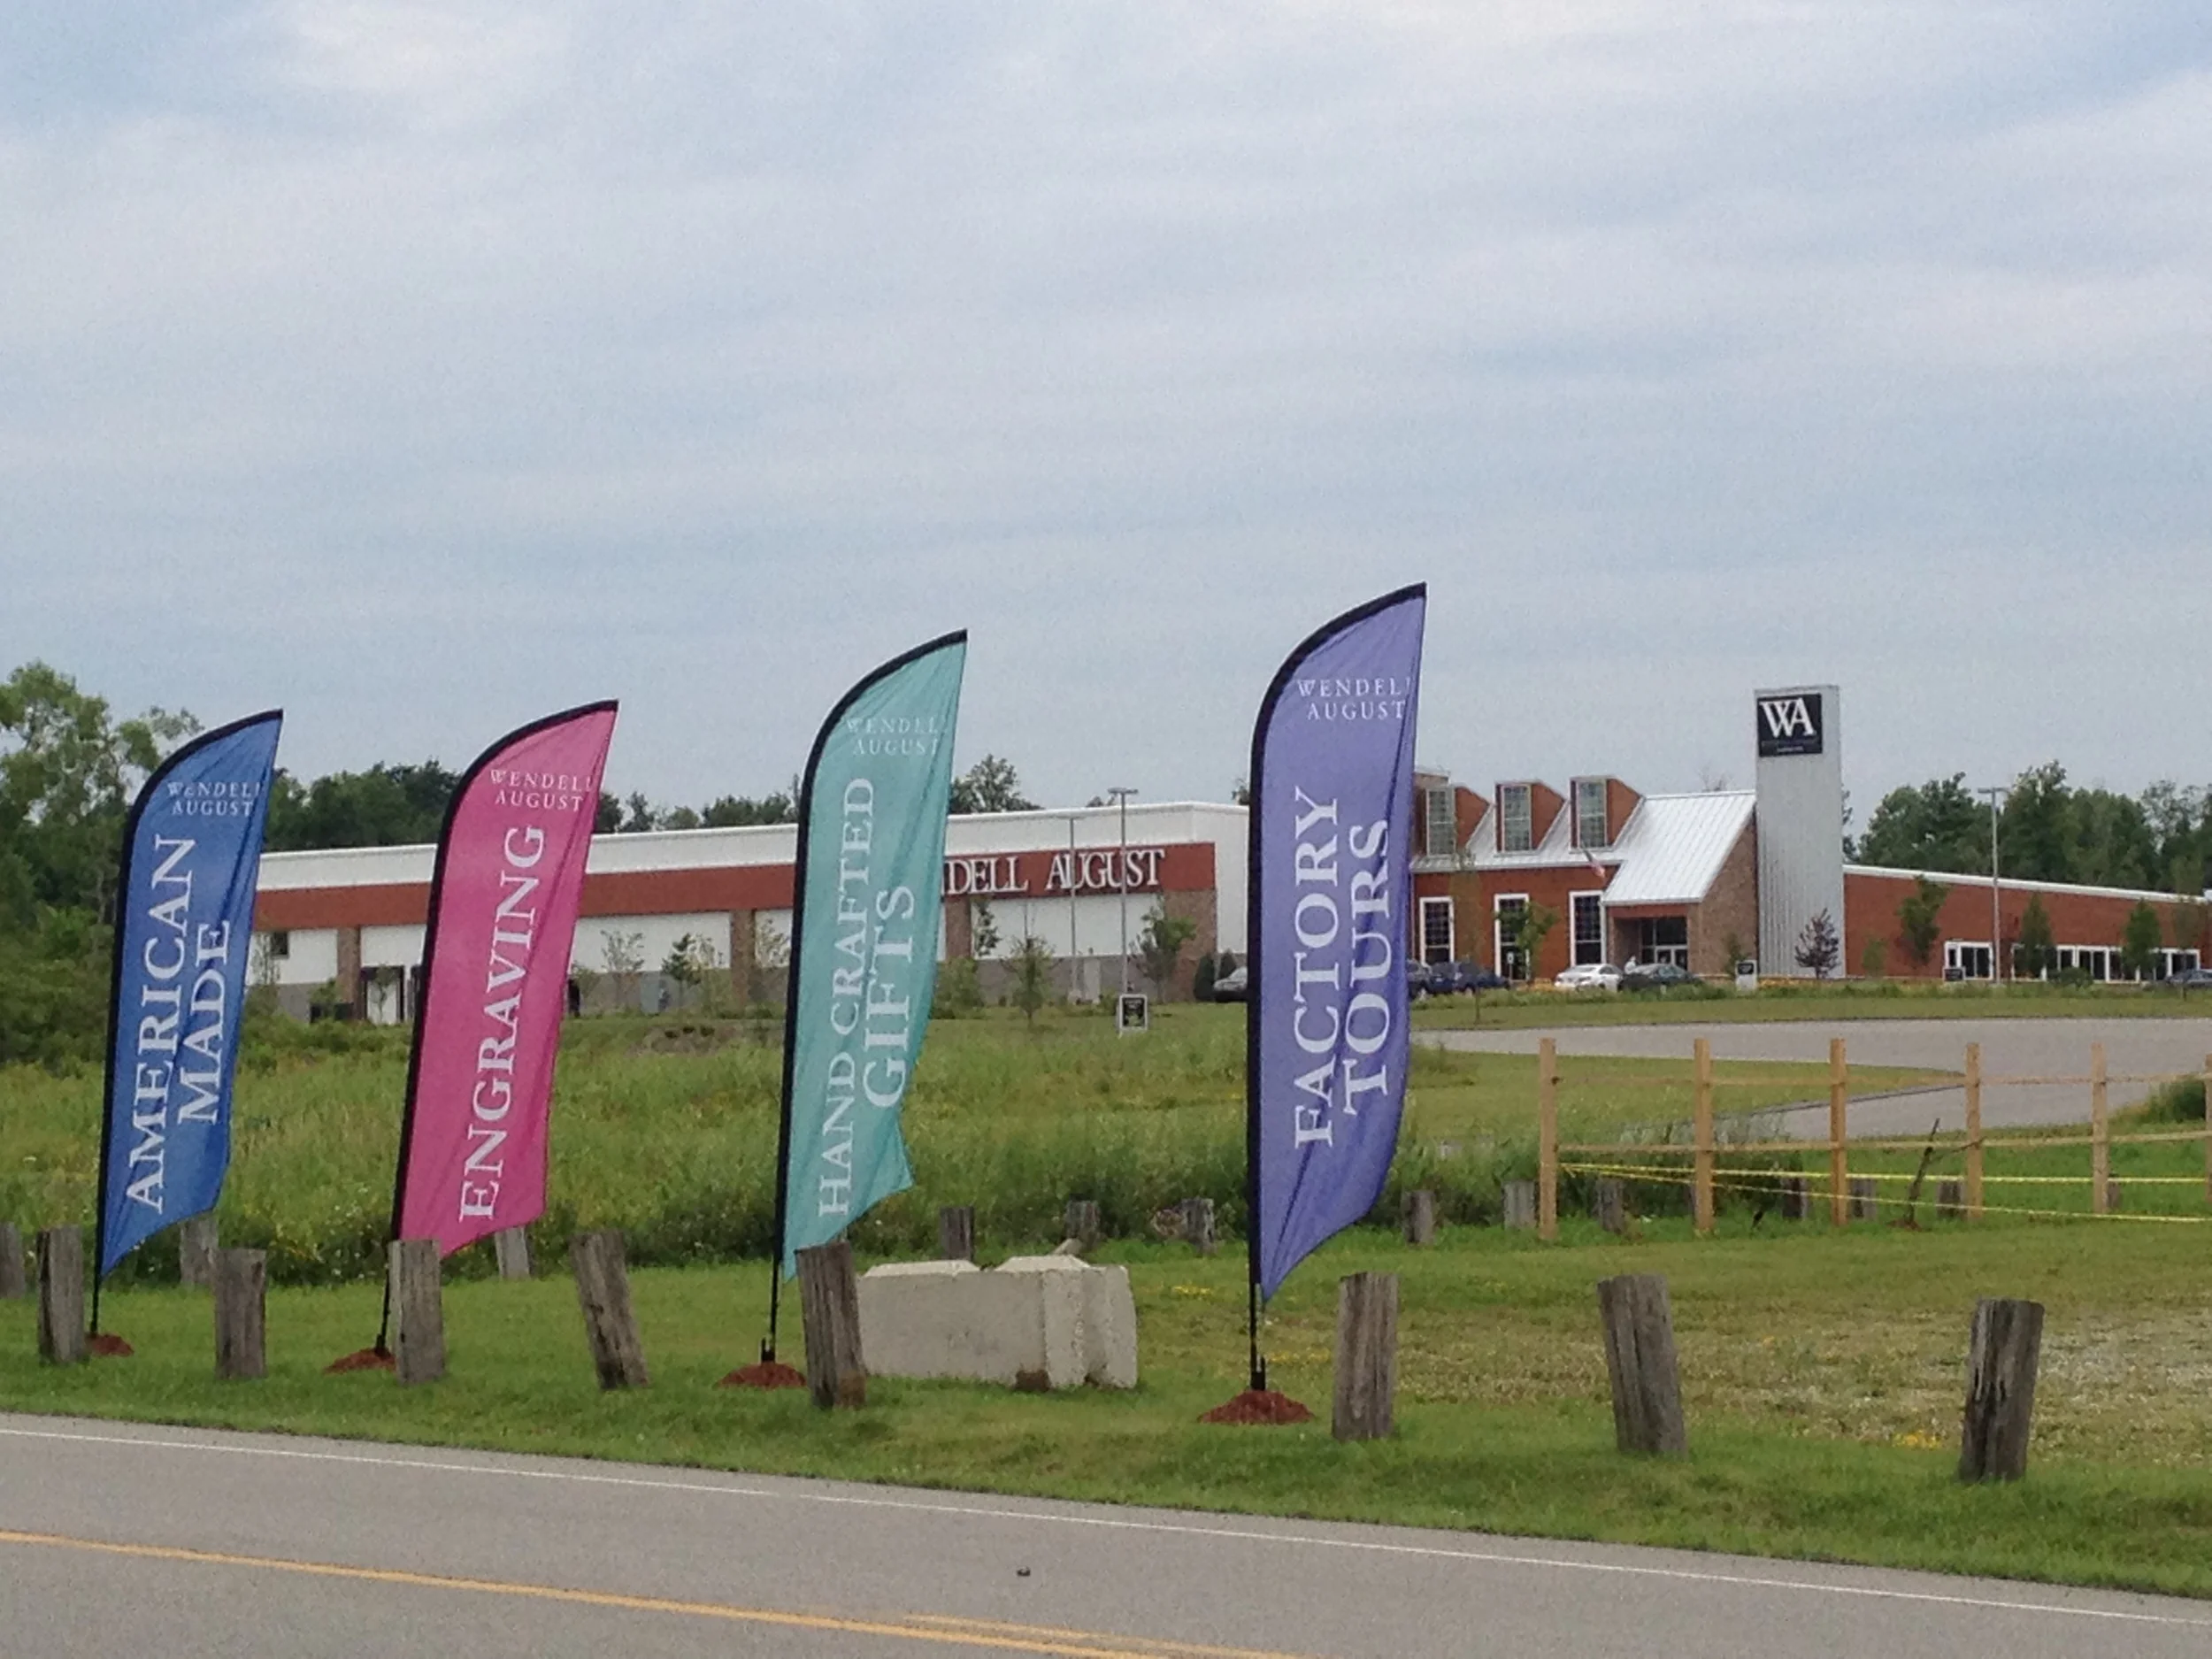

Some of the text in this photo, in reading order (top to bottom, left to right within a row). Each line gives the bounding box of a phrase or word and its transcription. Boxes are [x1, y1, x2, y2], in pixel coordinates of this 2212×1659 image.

[172, 800, 254, 817] AUGUST
[495, 789, 583, 812] AUGUST
[853, 739, 938, 756] AUGUST
[1307, 699, 1406, 720] AUGUST
[1758, 697, 1816, 738] WA
[1044, 849, 1165, 890] AUGUST
[1293, 785, 1339, 1149] FACTORY
[1344, 819, 1392, 1117] TOURS
[126, 833, 196, 1215] AMERICAN
[178, 919, 230, 1125] MADE
[458, 824, 544, 1220] ENGRAVING
[818, 778, 875, 1217] HAND CRAFTED
[864, 887, 915, 1108] GIFTS
